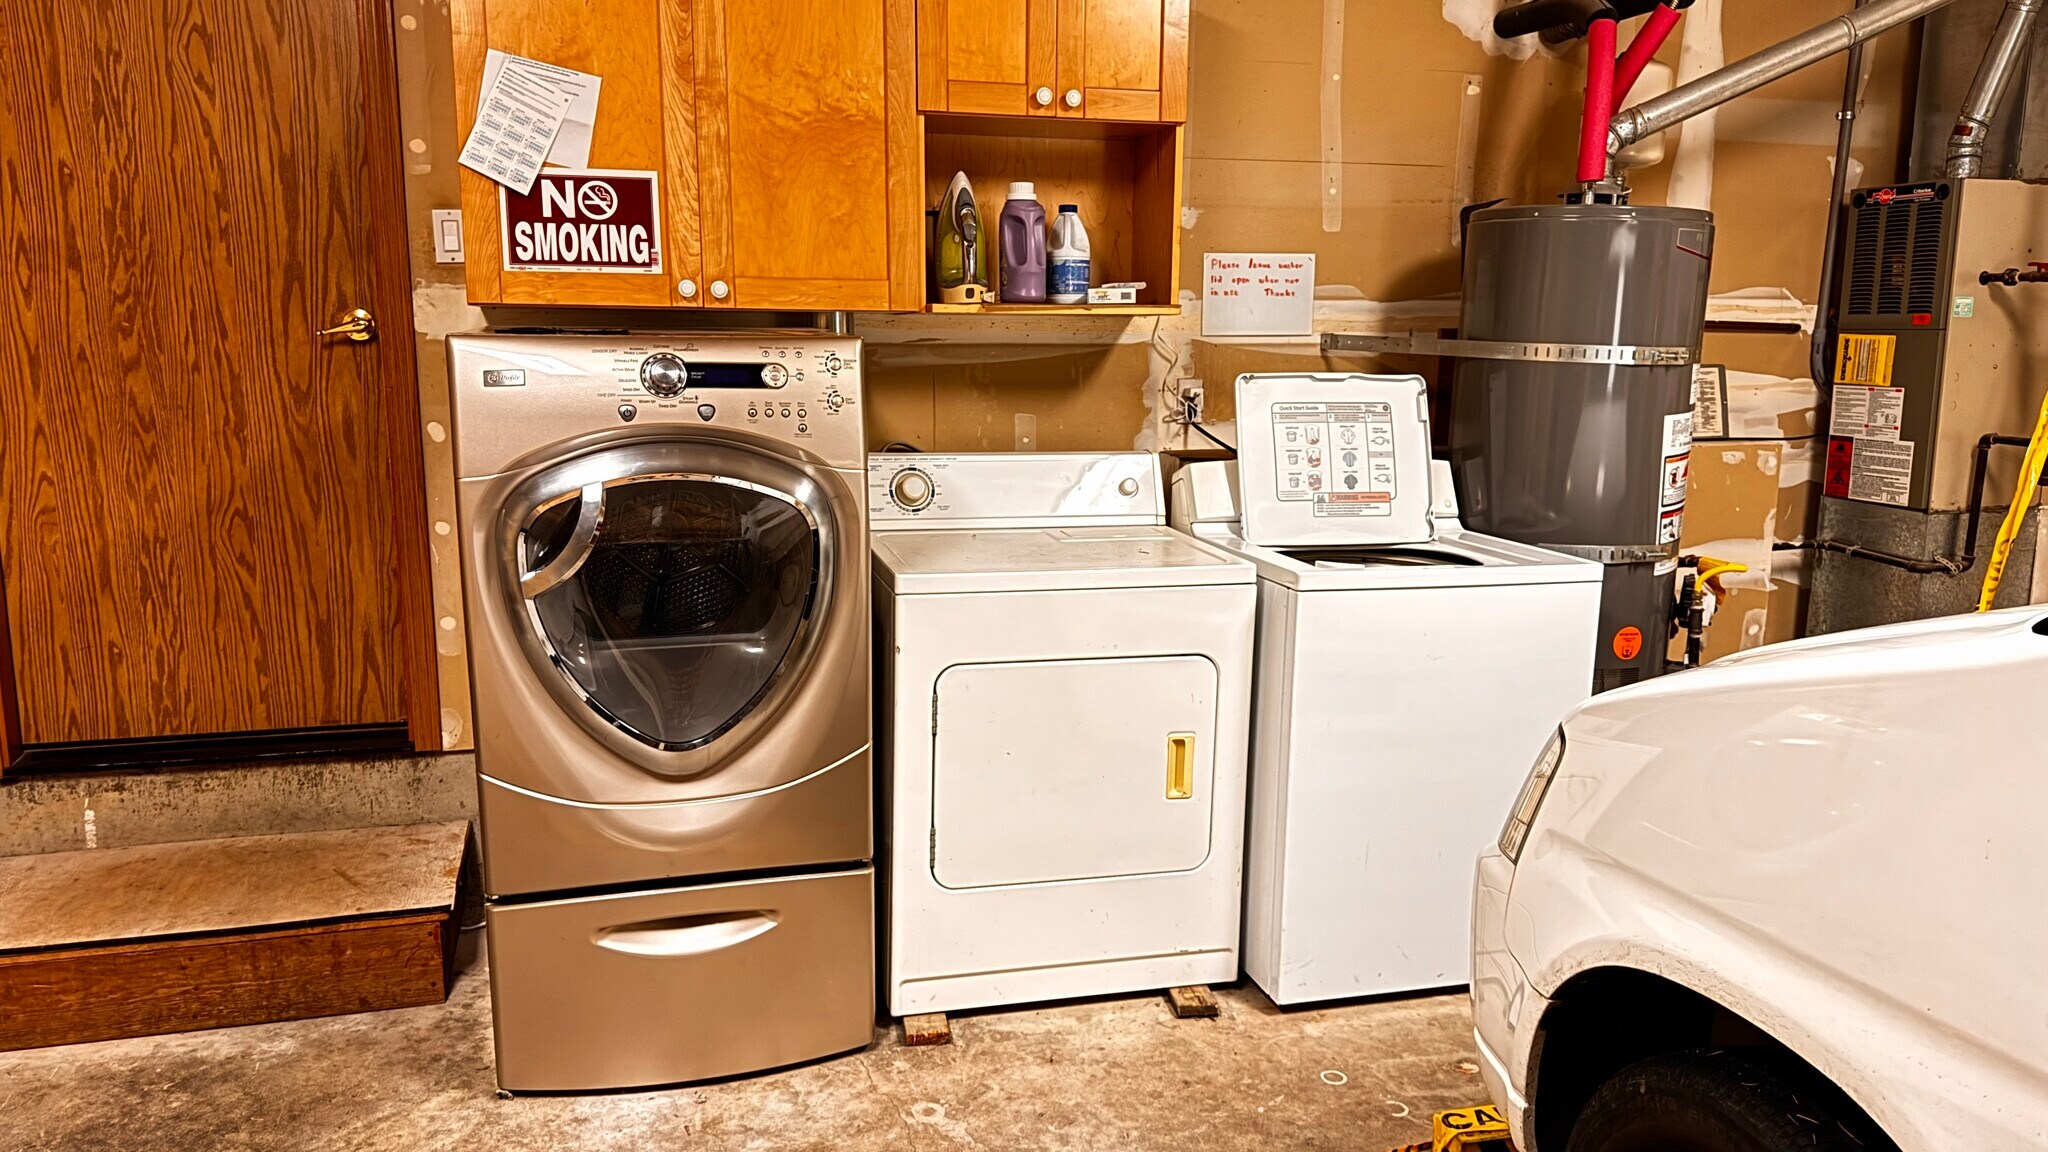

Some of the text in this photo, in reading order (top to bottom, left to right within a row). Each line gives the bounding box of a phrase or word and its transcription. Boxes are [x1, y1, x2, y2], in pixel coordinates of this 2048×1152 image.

[514, 221, 650, 263] SMOKING
[1211, 258, 1239, 270] Please
[1248, 258, 1271, 268] leave
[1211, 275, 1222, 283] lid
[1258, 275, 1278, 283] when
[1211, 288, 1218, 296] in
[1264, 288, 1295, 296] Thanks
[1441, 1107, 1503, 1129] CA
